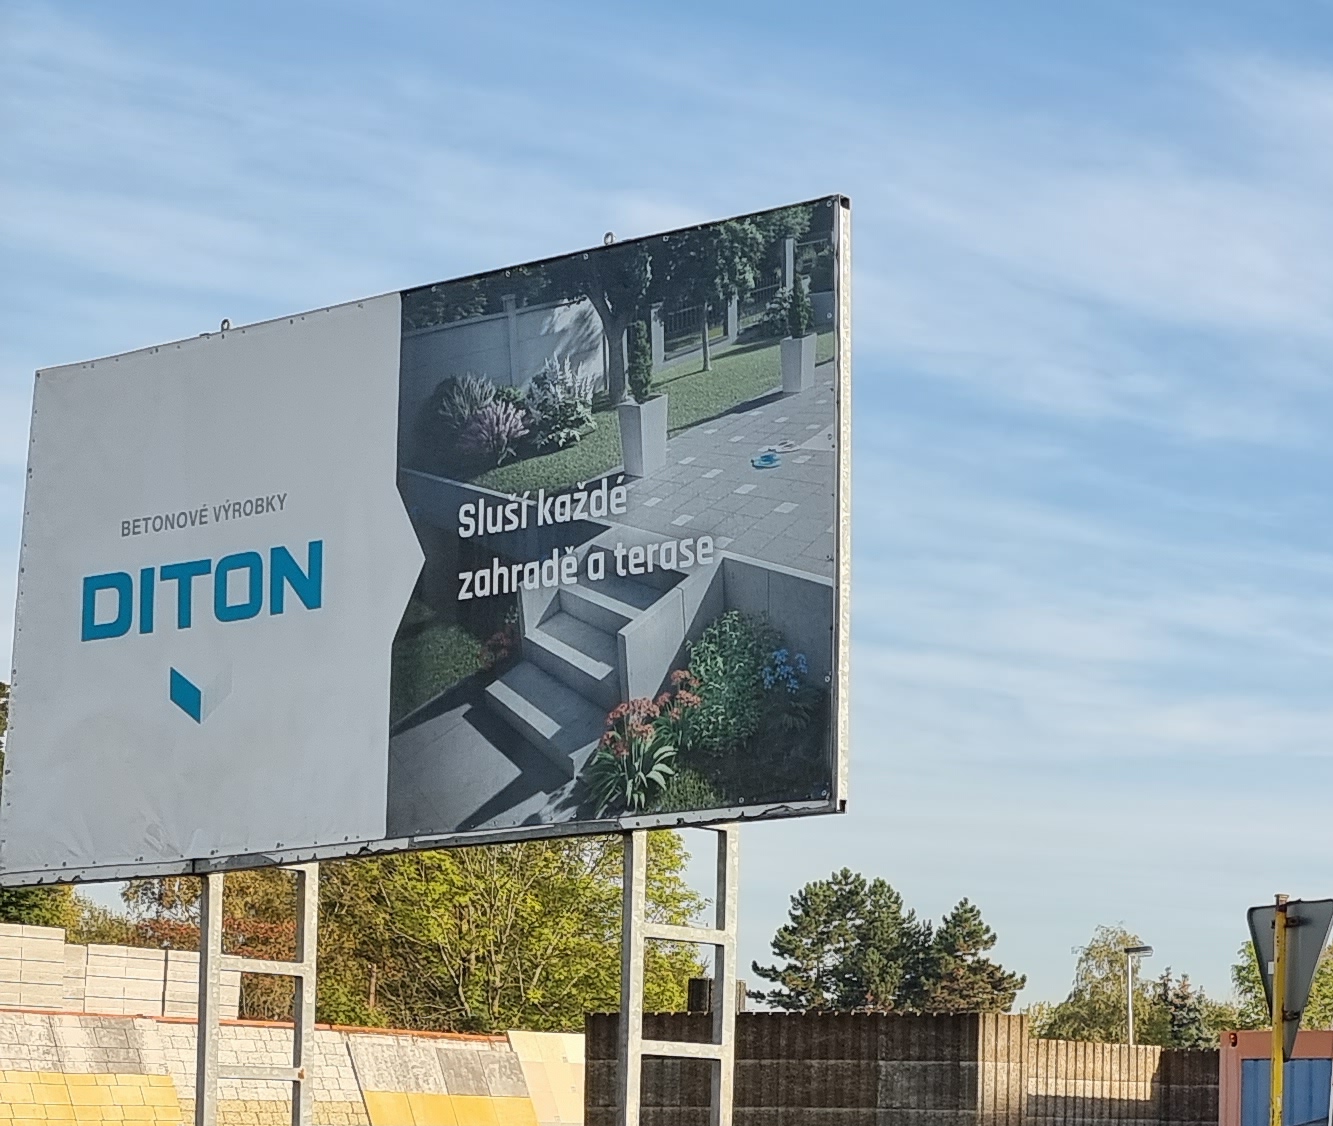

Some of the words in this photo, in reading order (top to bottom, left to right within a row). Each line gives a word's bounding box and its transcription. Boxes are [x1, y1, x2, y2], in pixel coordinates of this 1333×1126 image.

[121, 503, 209, 537] BETONOVÉ
[213, 493, 287, 522] VÝROBKY
[458, 490, 530, 538] Sluší
[537, 475, 627, 527] každé
[81, 540, 323, 642] DITON
[458, 546, 578, 600] zahradě
[587, 550, 605, 581] a
[614, 535, 714, 577] terase
